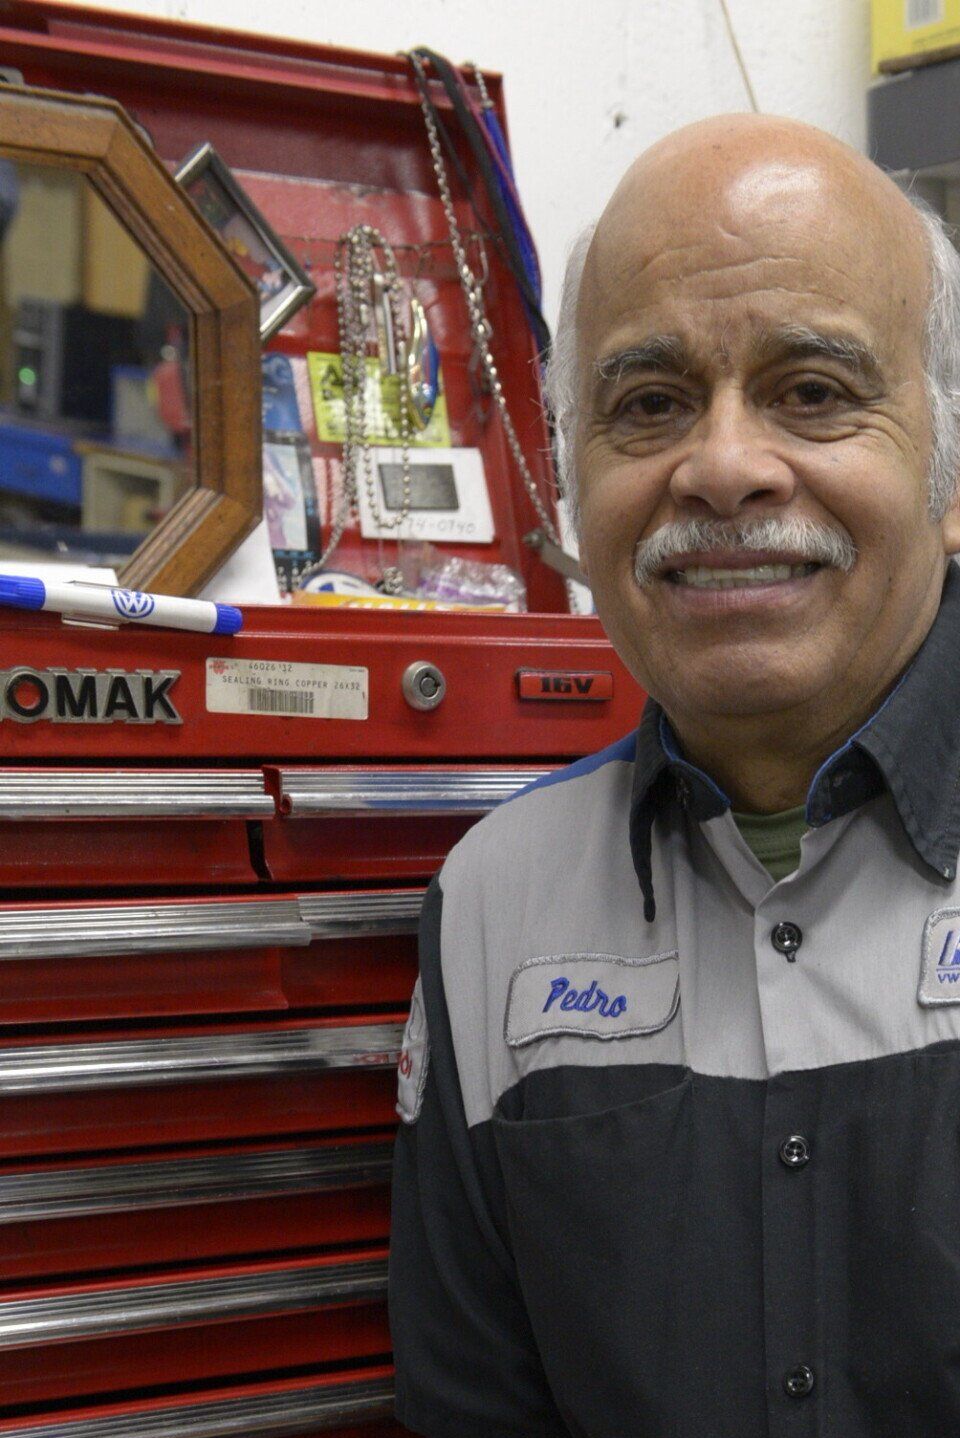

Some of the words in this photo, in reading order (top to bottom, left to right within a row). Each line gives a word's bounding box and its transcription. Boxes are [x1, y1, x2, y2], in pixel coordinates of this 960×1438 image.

[222, 675, 262, 685] SEALING
[267, 677, 290, 687] RING
[295, 679, 328, 688] COPPER
[541, 677, 593, 693] 16V
[542, 976, 628, 1018] Pedro
